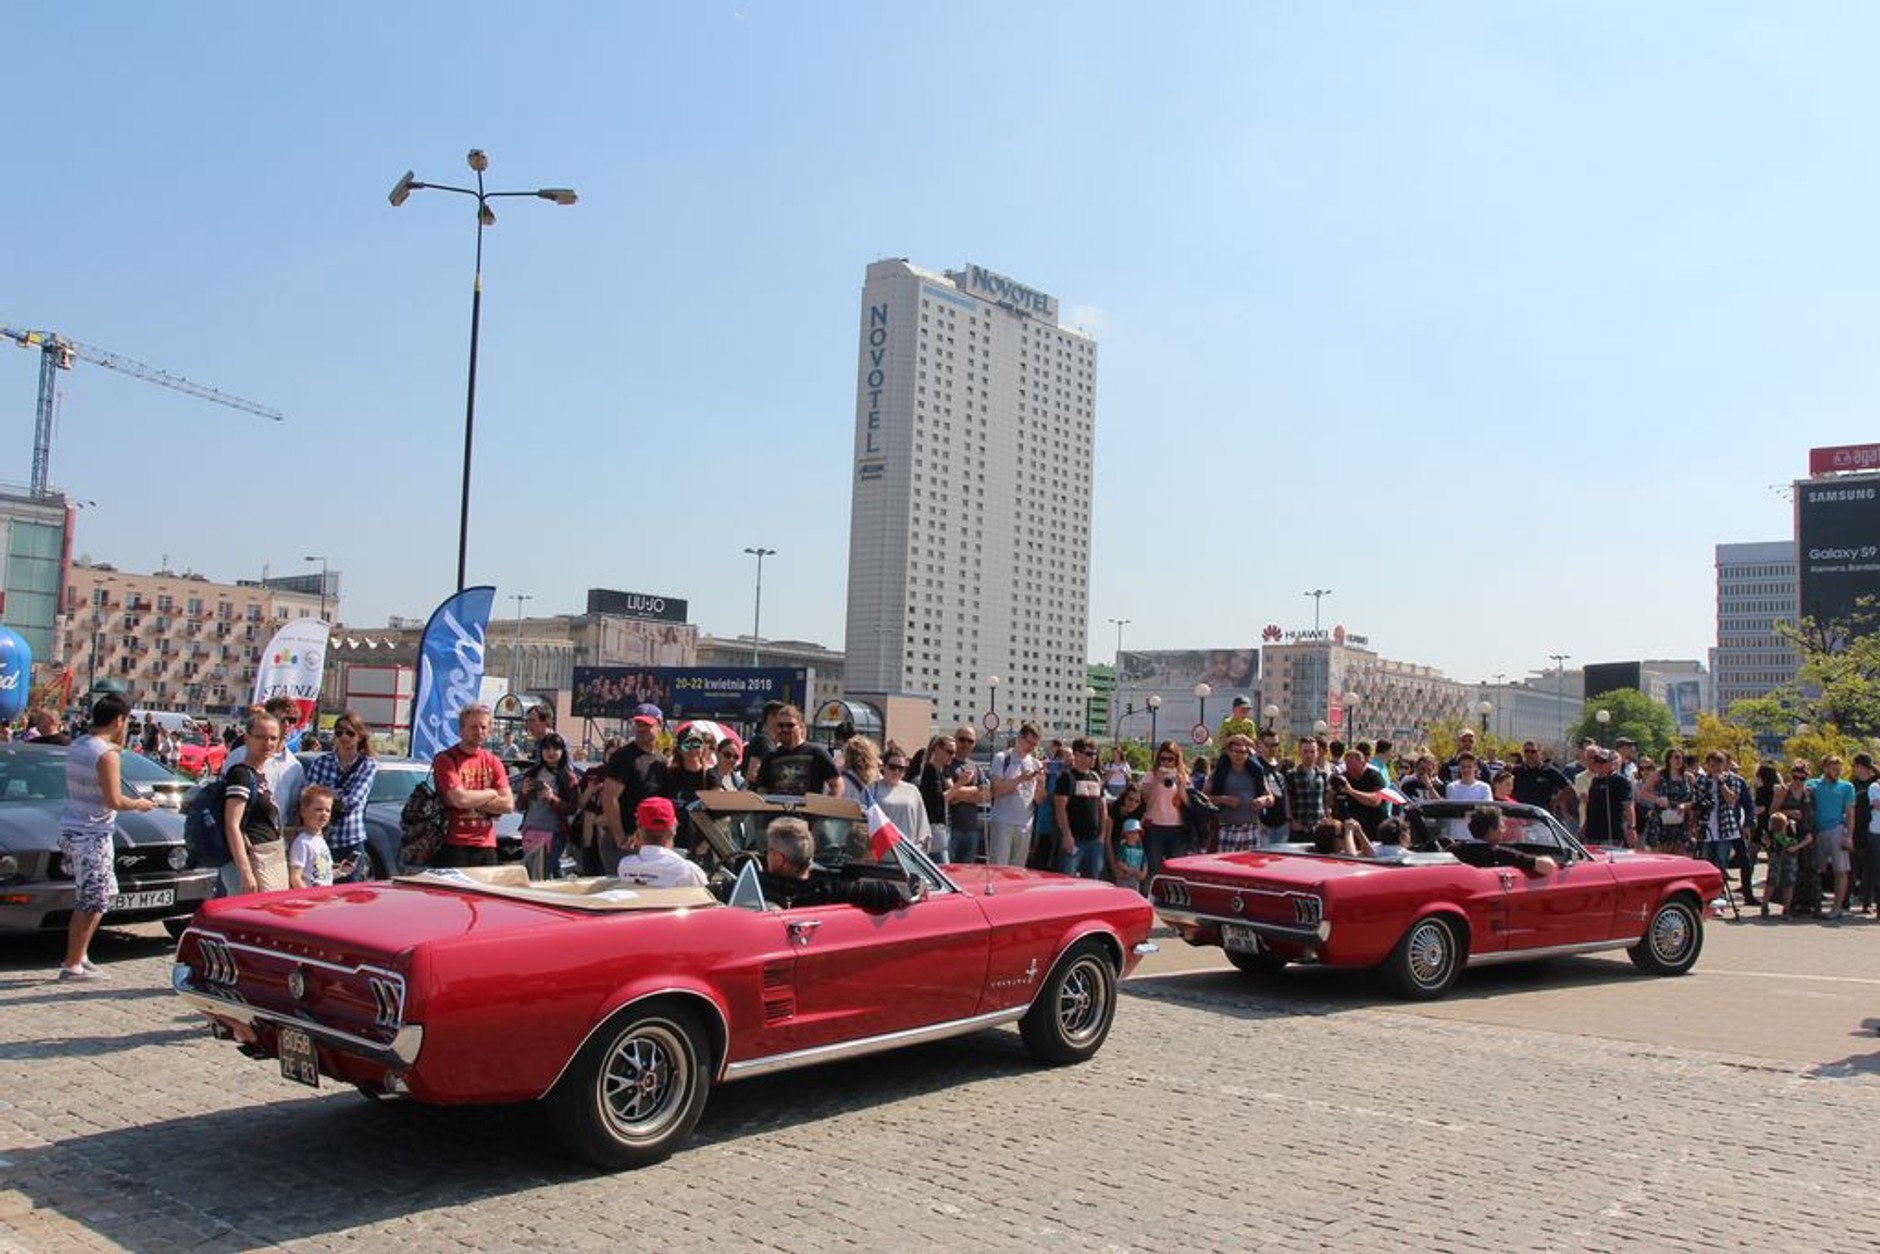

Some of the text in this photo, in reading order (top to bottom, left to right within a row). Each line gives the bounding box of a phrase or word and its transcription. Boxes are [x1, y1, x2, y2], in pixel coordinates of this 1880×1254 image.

[972, 265, 1053, 316] NOVOTEL
[867, 303, 887, 452] NOVOTEL
[1808, 488, 1875, 502] SAMSUNG
[1809, 546, 1878, 559] Galaxy S9
[1285, 629, 1329, 640] HUAWEI
[675, 677, 773, 691] 20-22 kwietnia 2018
[114, 893, 135, 909] BY
